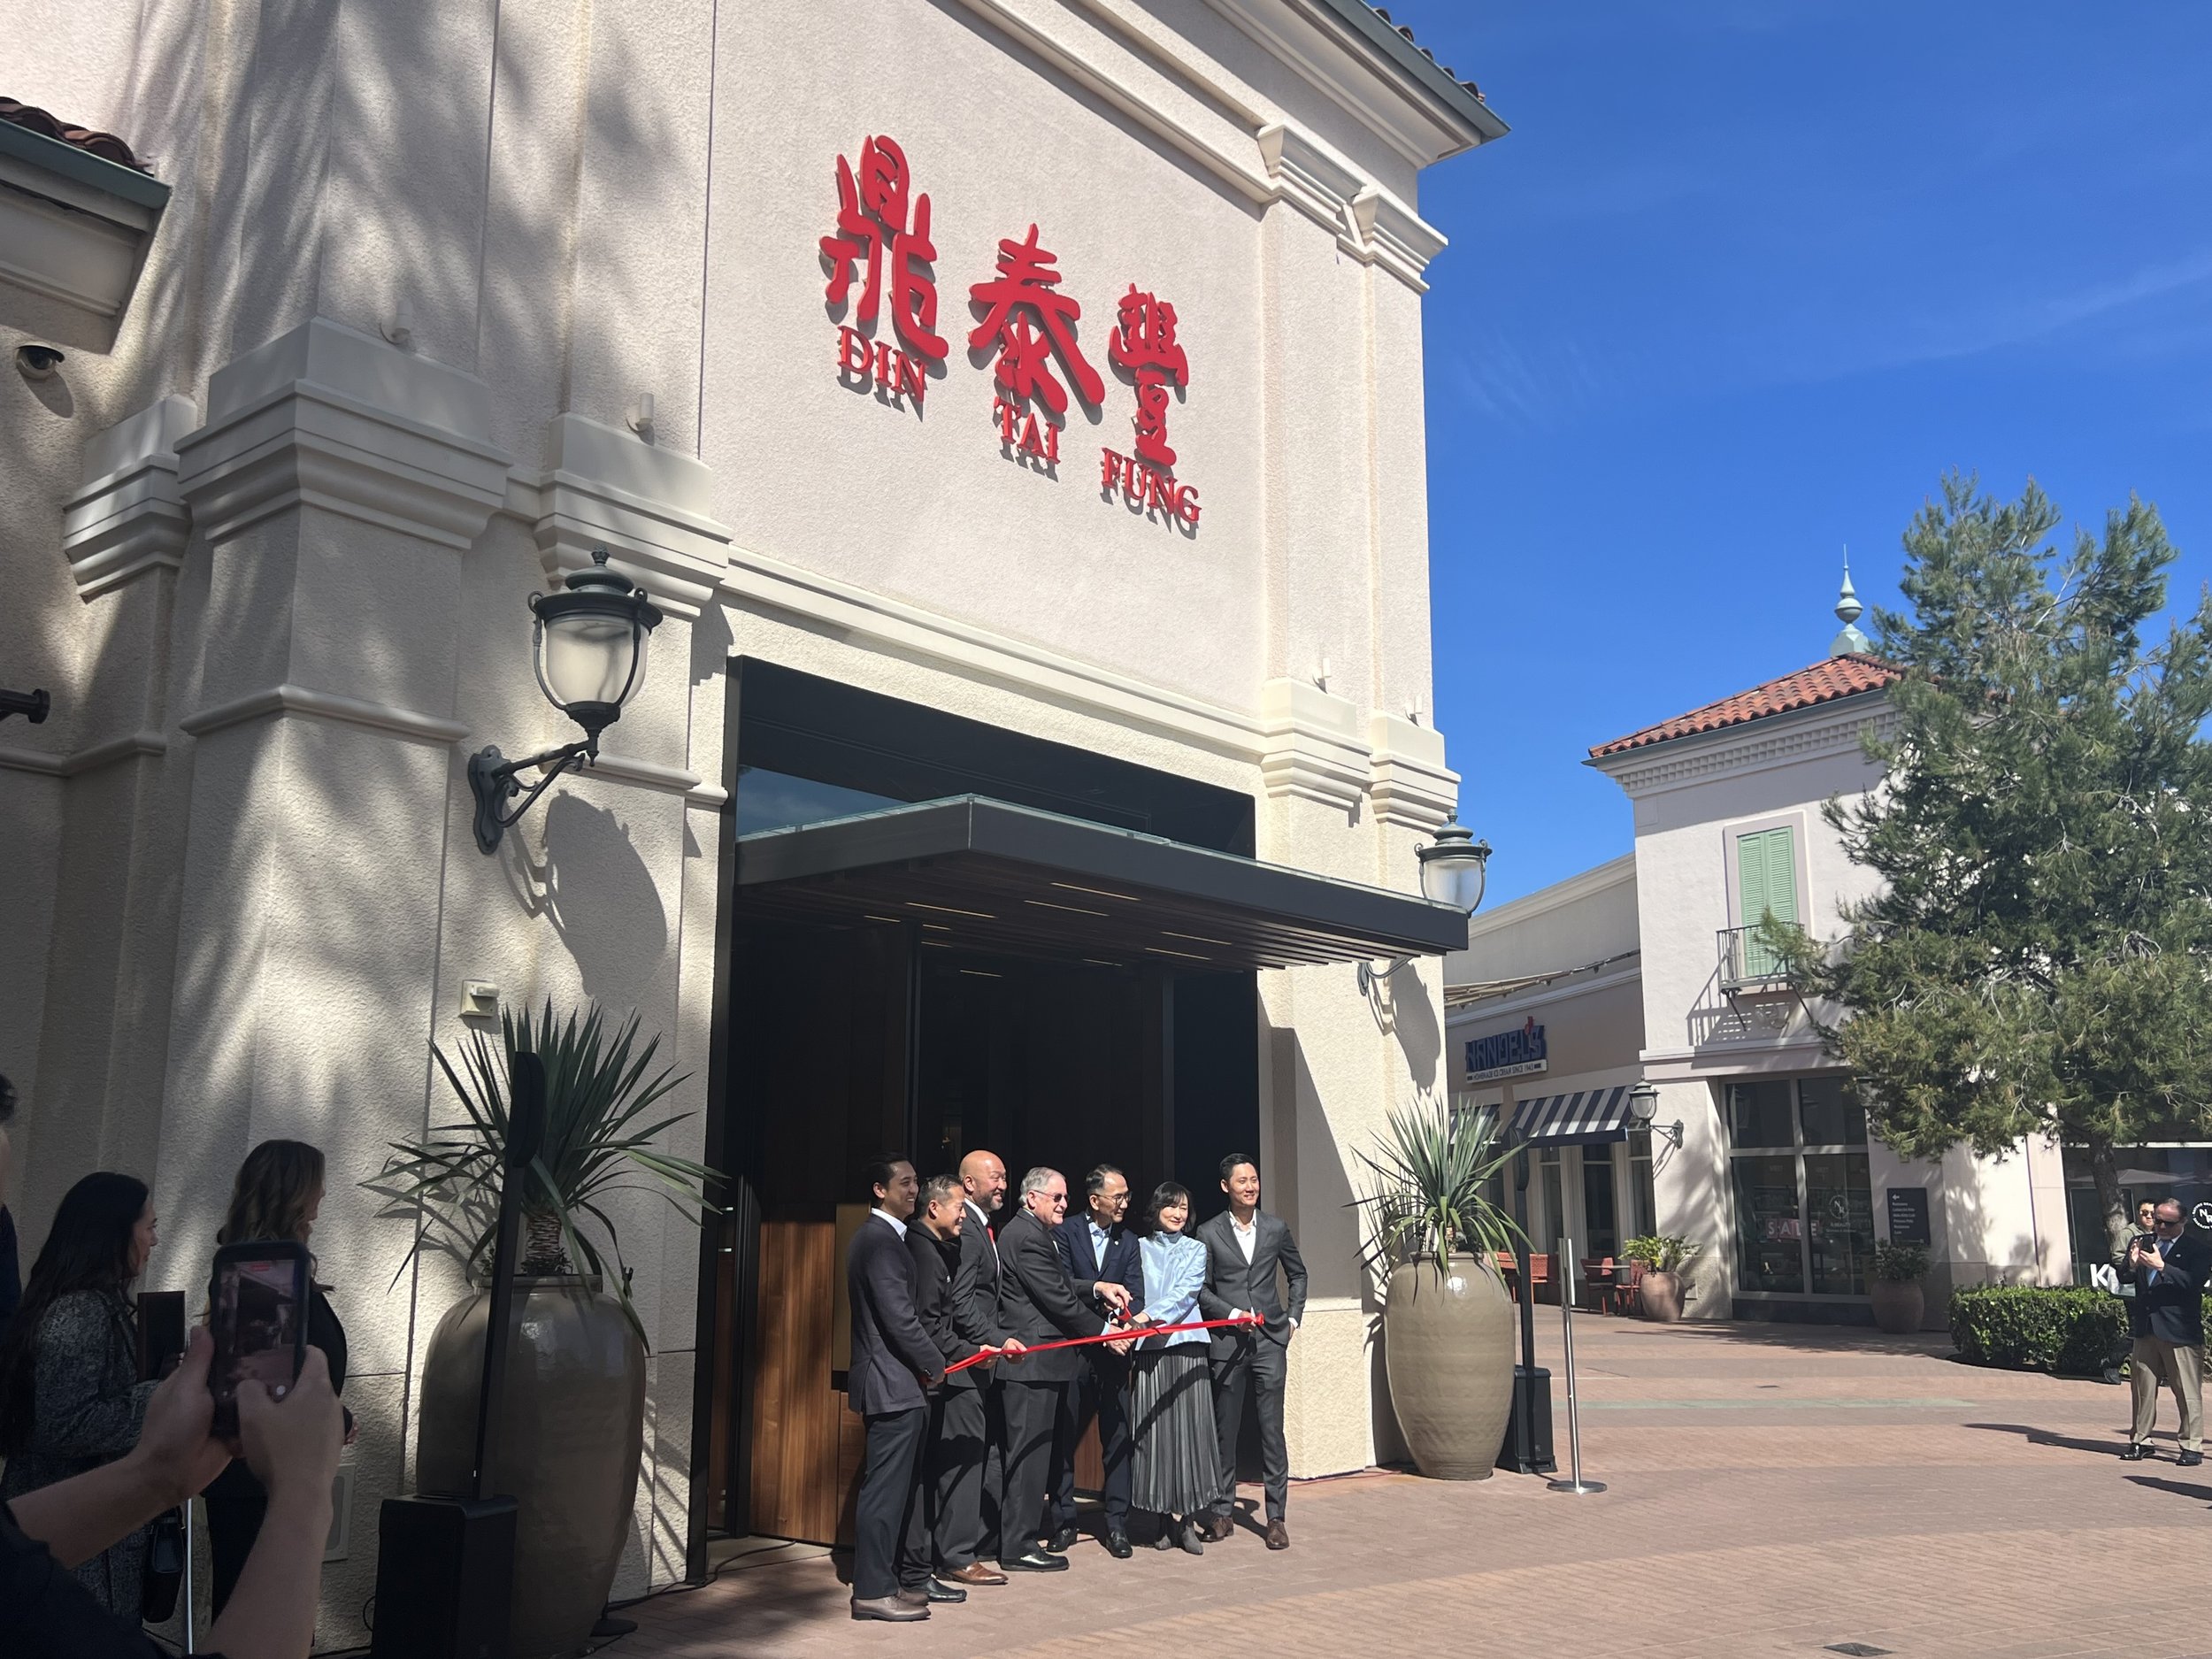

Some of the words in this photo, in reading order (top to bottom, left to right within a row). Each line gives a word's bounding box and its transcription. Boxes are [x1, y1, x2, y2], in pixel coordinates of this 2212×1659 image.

[837, 325, 928, 403] DIN
[994, 396, 1060, 465] TAI
[1101, 447, 1202, 523] FUNG
